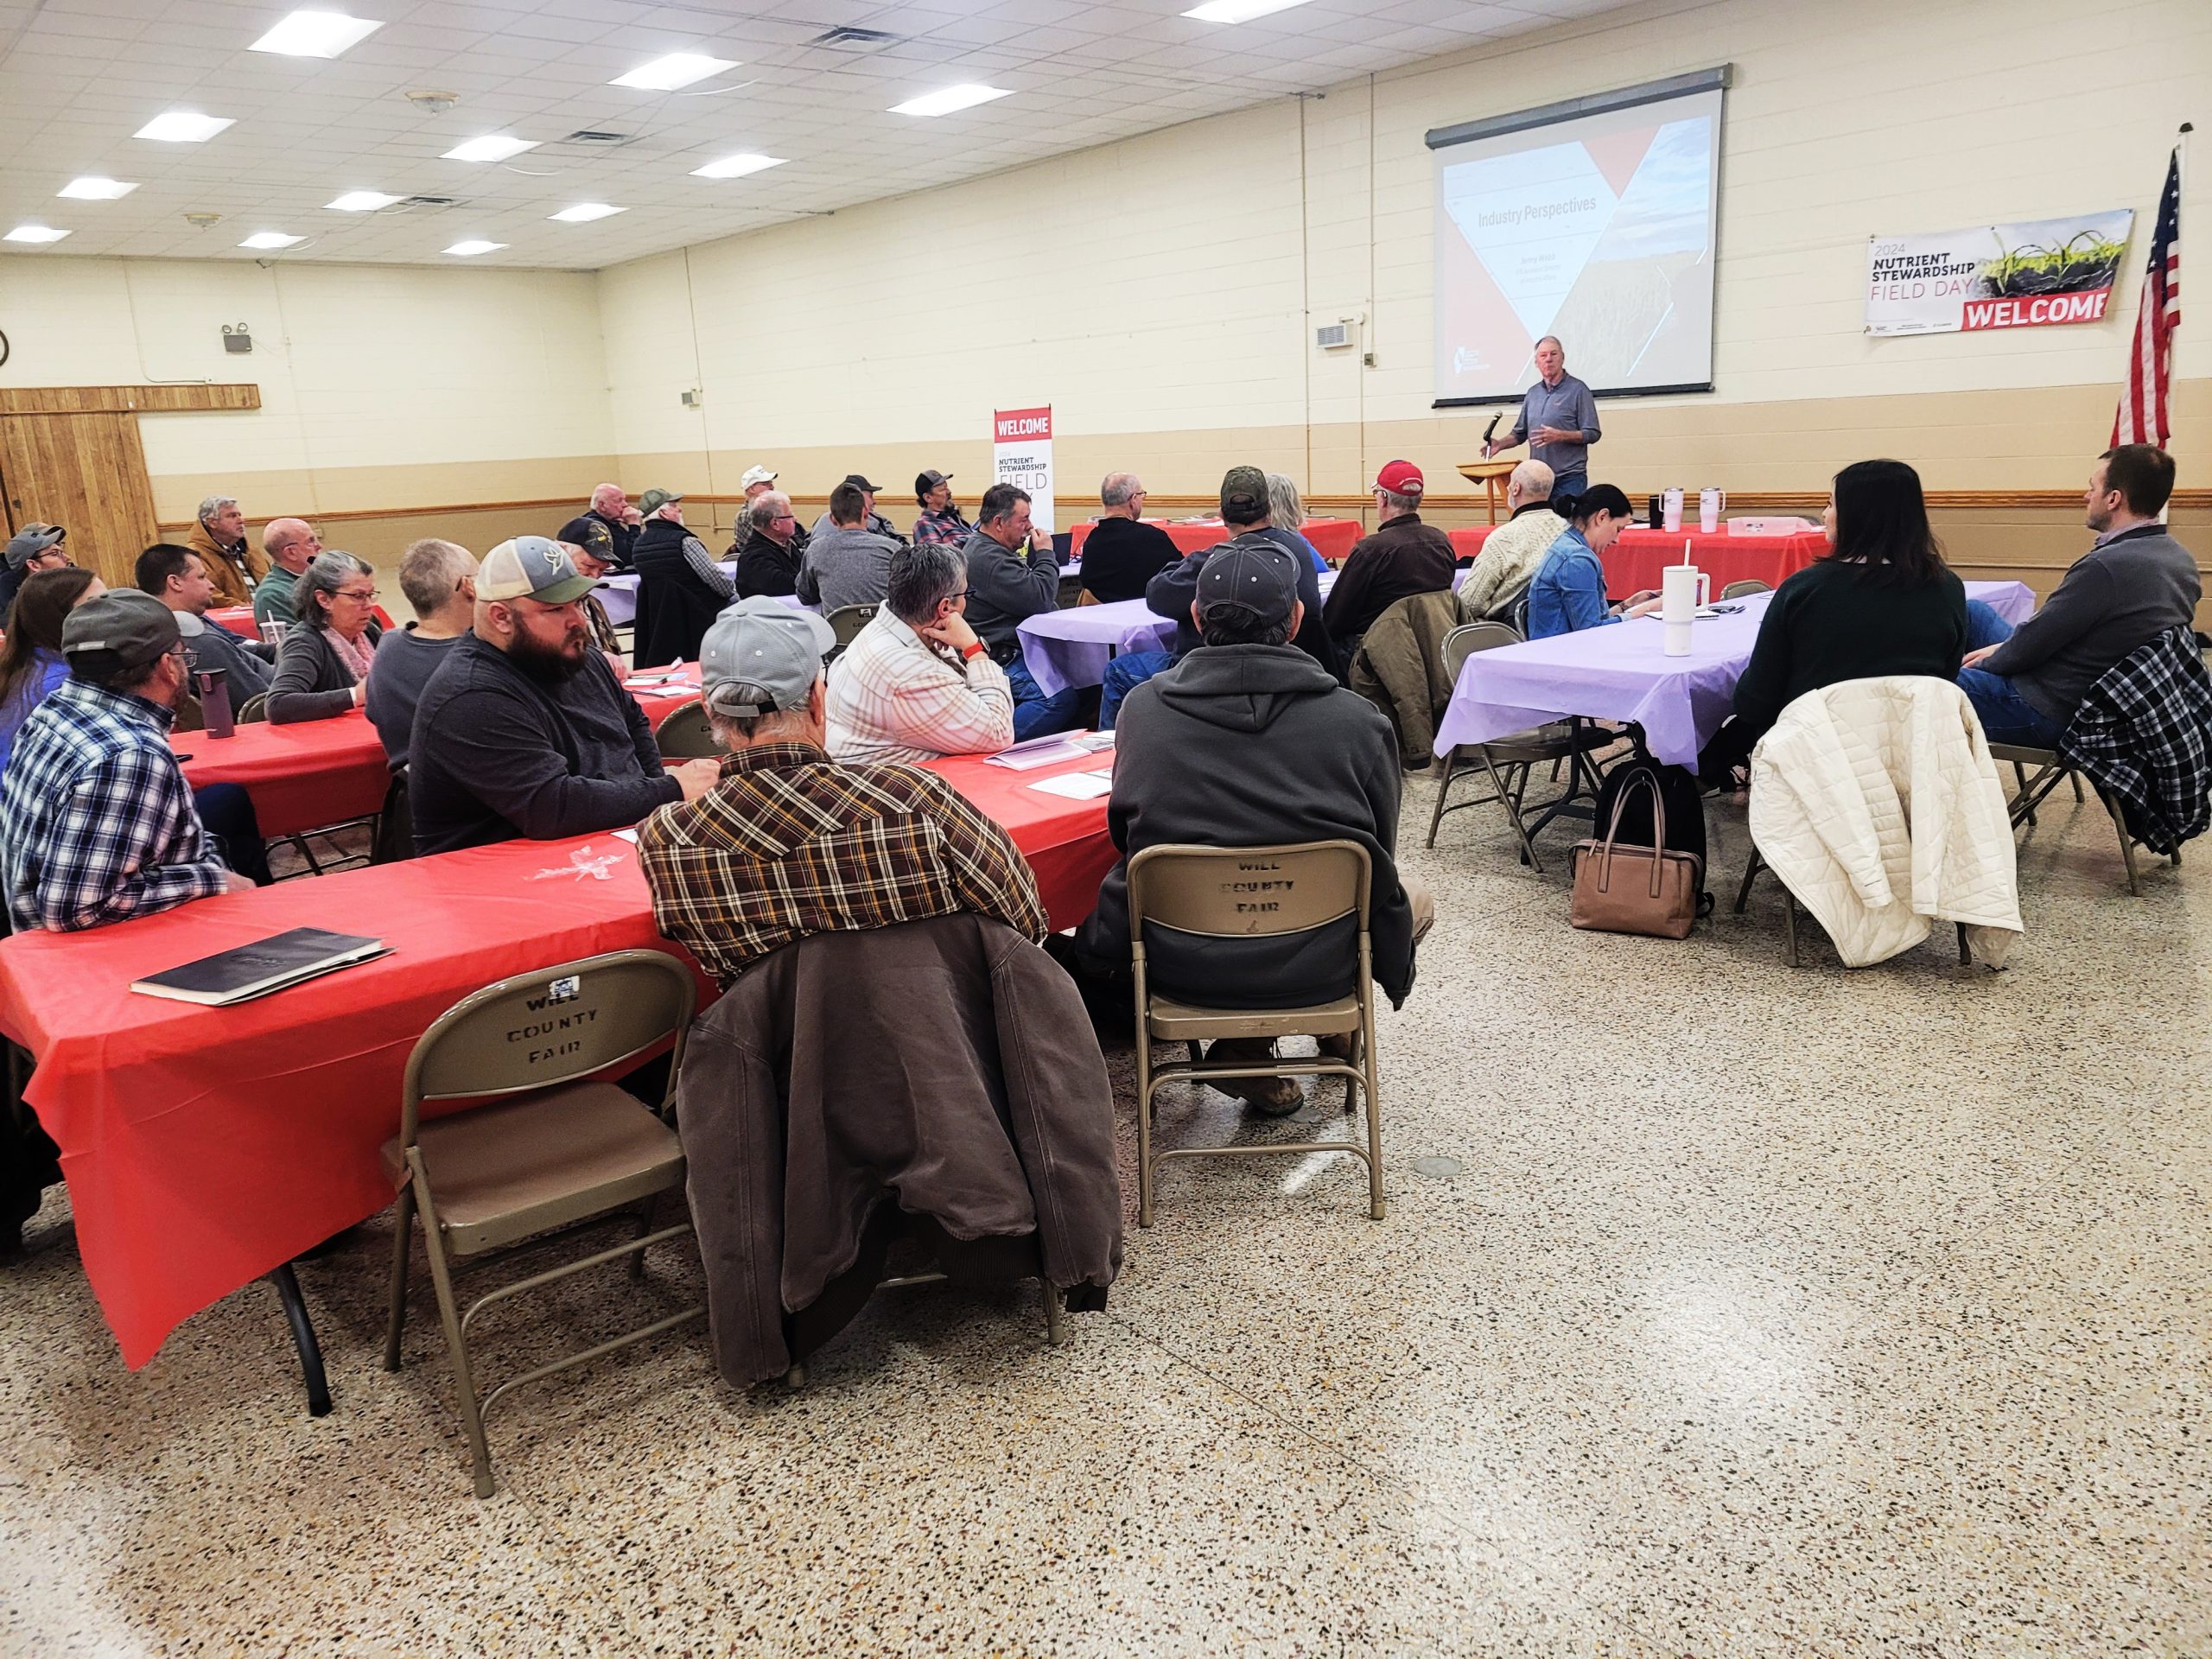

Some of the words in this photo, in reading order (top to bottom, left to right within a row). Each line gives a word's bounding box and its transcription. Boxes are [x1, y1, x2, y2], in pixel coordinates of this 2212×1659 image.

[1478, 210, 1522, 228] Industry
[1524, 197, 1597, 219] Perspectives
[1874, 244, 1906, 257] 2024
[1872, 252, 1951, 270] NUTRIENT
[1872, 262, 1976, 282] STEWARDSHIP
[1870, 283, 1925, 301] FIELD
[1935, 277, 1974, 296] DAY
[1966, 292, 2108, 328] WELCOME
[997, 416, 1049, 436] WELCOME
[999, 457, 1034, 466] NUTRIENT
[999, 463, 1047, 473] STEWARDSHIP
[1239, 861, 1281, 871] WILL
[1236, 902, 1280, 913] FAIR
[506, 1008, 597, 1042] COUNTY
[529, 1040, 581, 1064] FAIR
